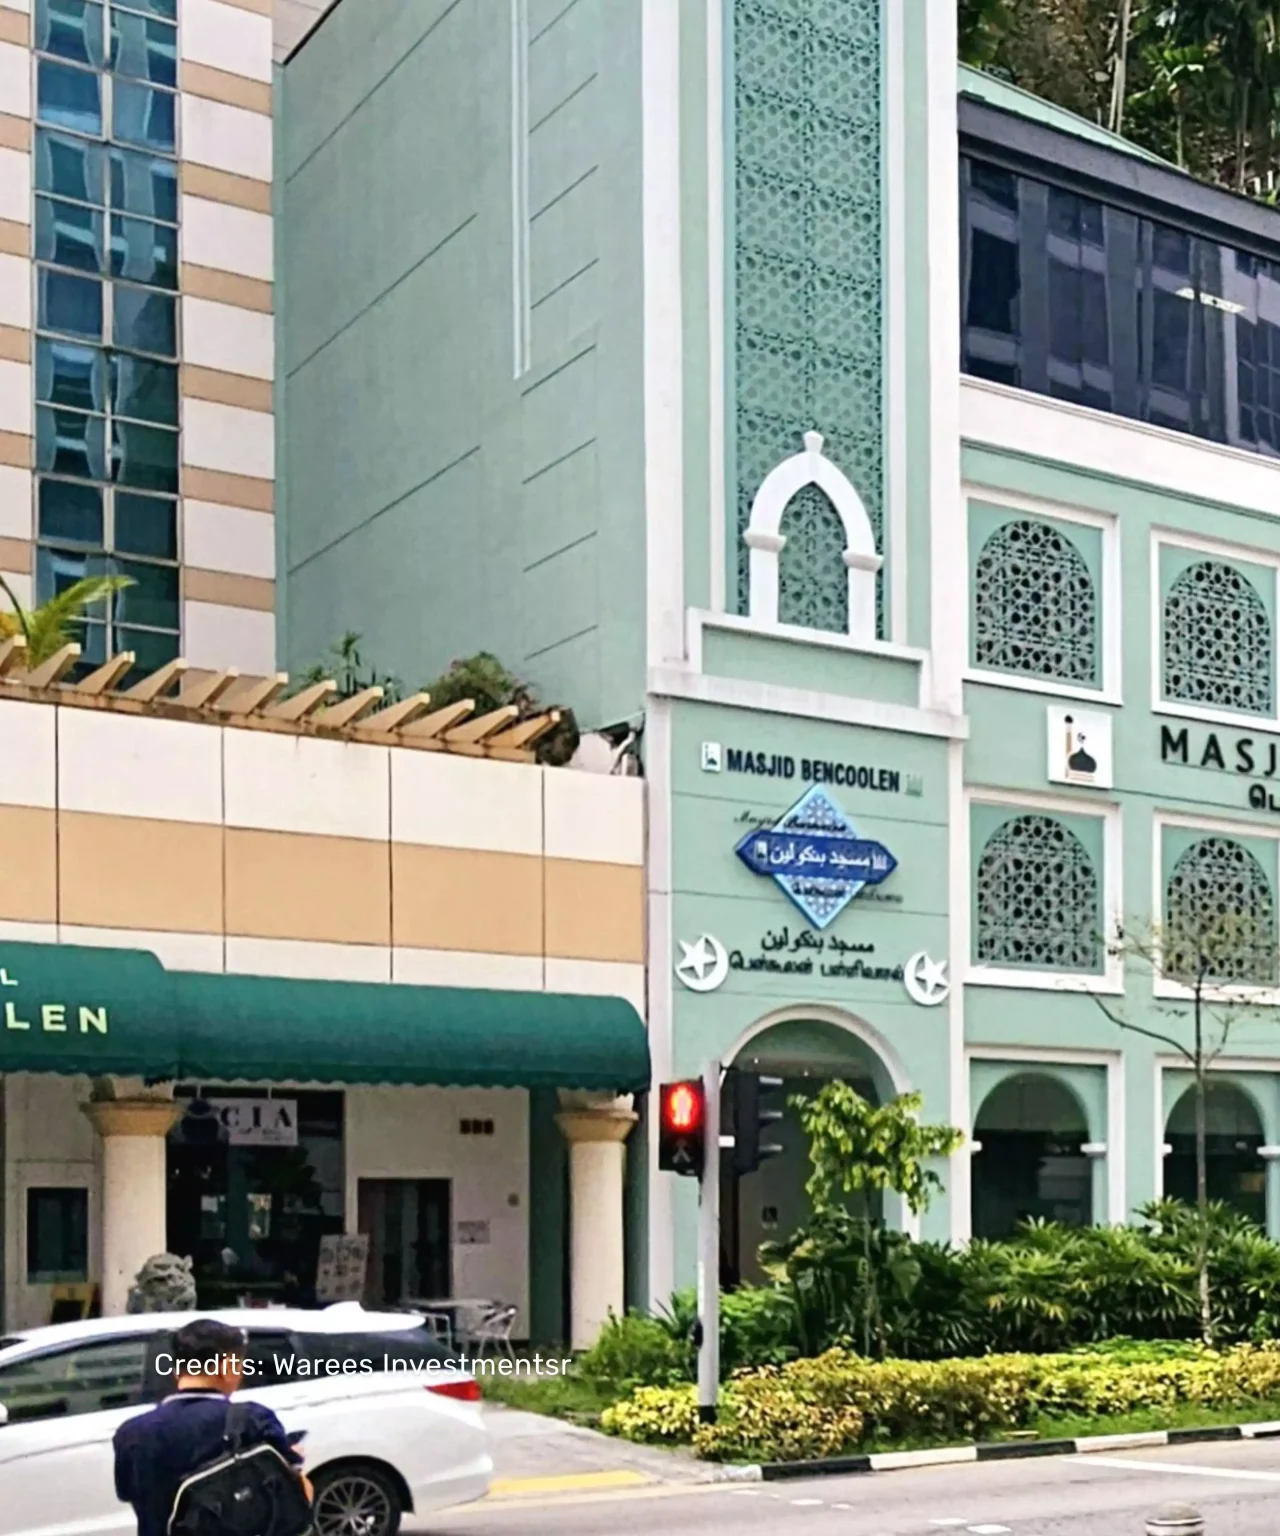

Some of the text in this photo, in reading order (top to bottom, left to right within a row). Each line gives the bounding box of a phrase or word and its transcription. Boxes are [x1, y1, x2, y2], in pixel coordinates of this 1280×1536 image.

[726, 748, 900, 792] MASJID BENCOOLEN
[828, 935, 875, 956] مسجد
[5, 1002, 107, 1034] LEN
